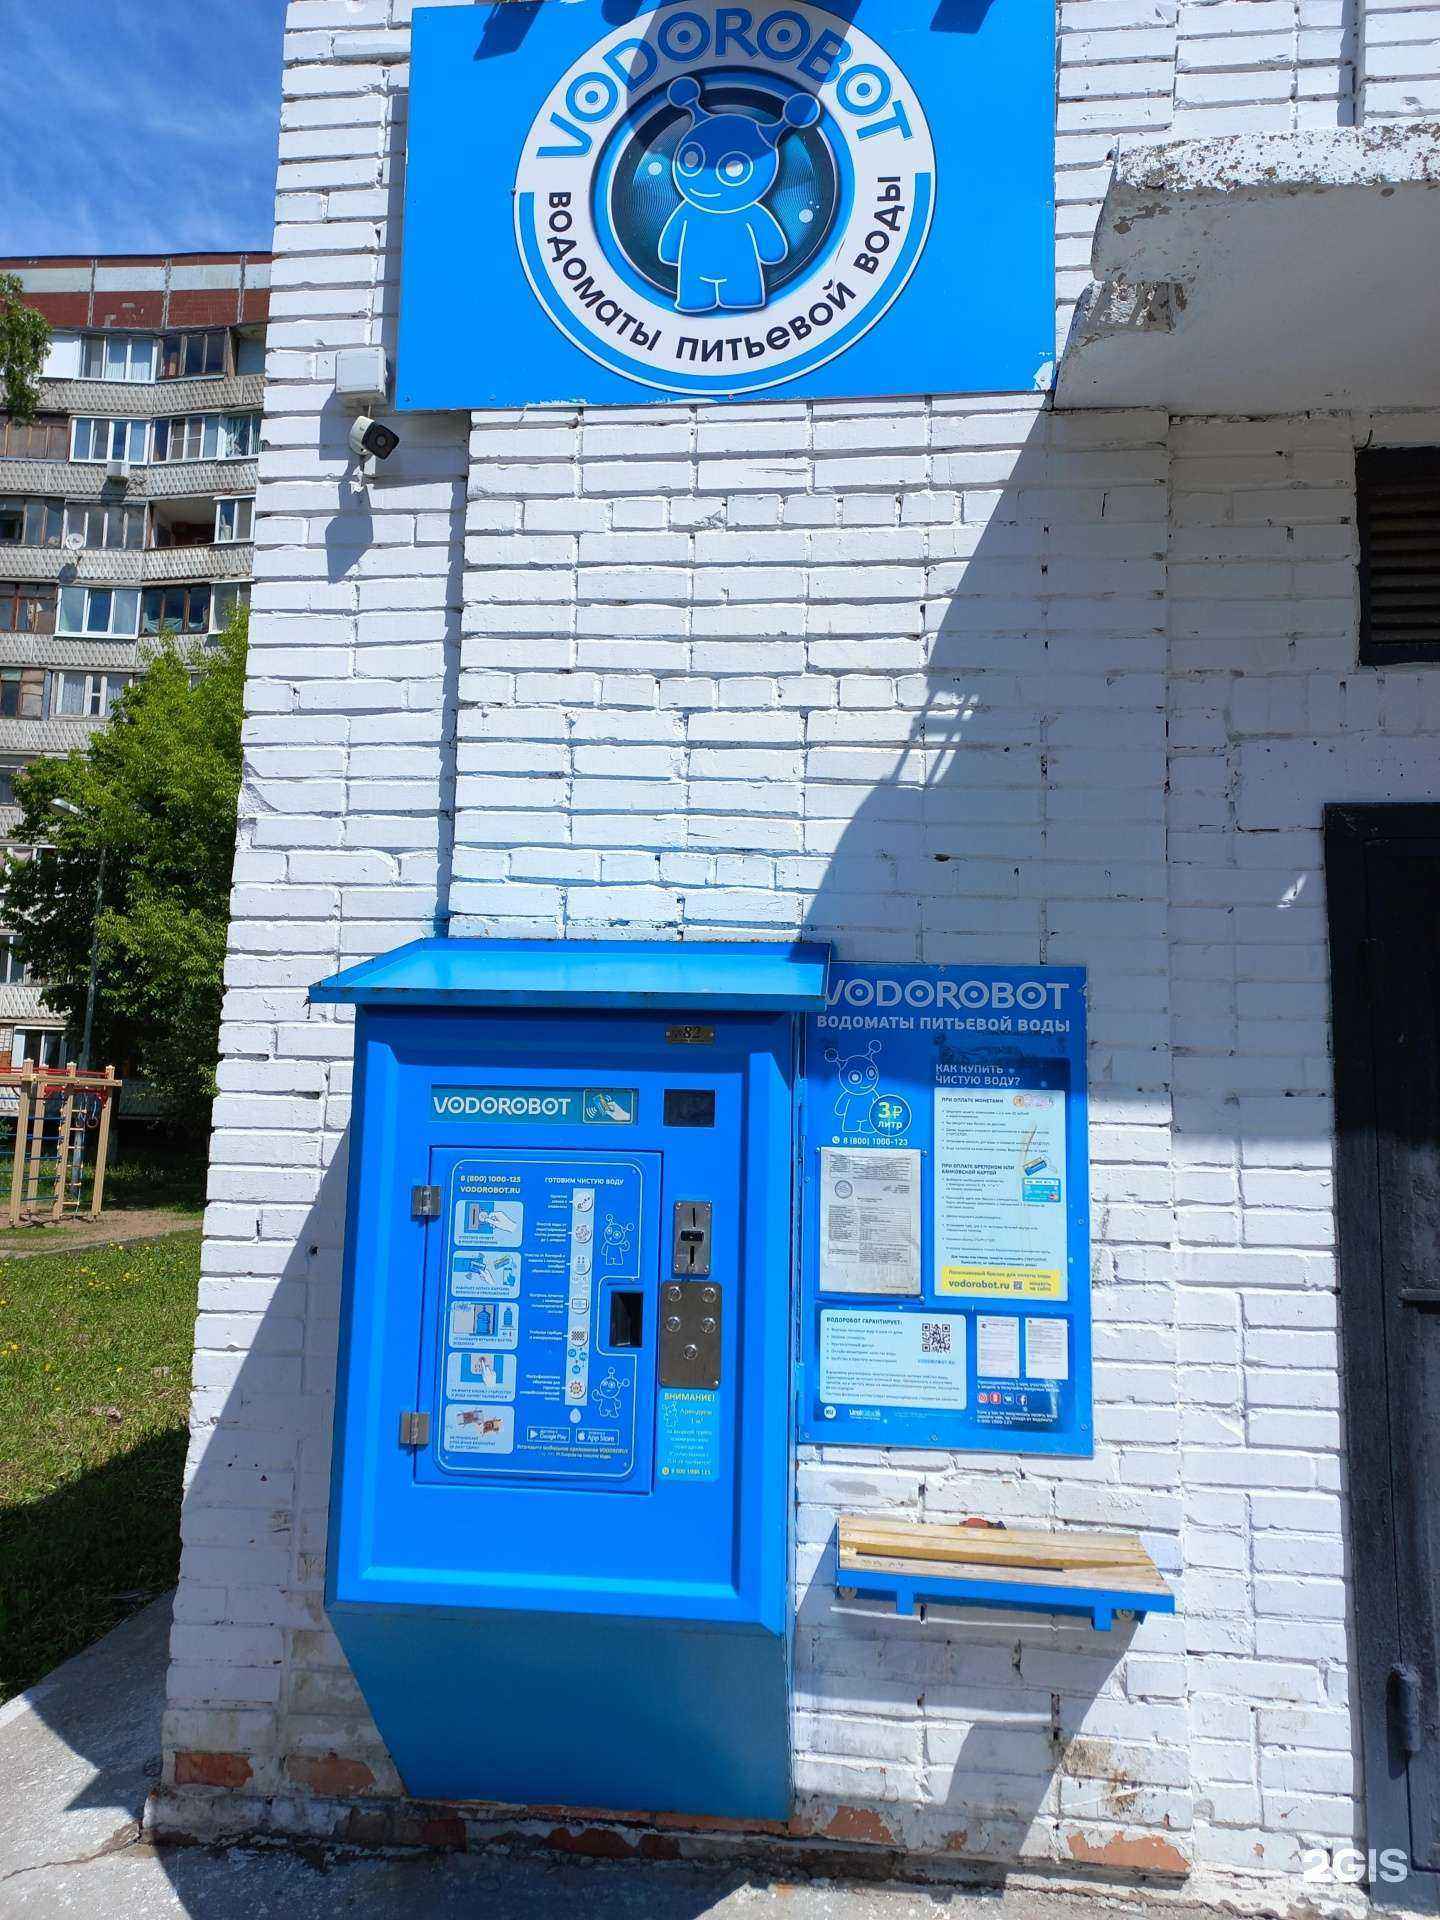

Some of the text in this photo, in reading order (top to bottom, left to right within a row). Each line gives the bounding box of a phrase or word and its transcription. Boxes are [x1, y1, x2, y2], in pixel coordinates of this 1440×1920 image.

[537, 7, 912, 160] VODOROBOT
[826, 978, 1071, 1010] VODOROBOT
[817, 1015, 1070, 1034] ВОДОМАТЫ ПИТЬЕВОЙ ВОДЫ
[936, 1063, 1004, 1074] КАК КУПИТЬ
[935, 1075, 1021, 1087] ЧИСТУЮ ВОДУ?
[433, 1096, 571, 1116] VODOROBOT
[878, 1121, 903, 1130] литр
[605, 1178, 624, 1186] ВОДУ
[460, 1186, 521, 1194] VODOROBOT.RU
[948, 1280, 1010, 1289] vodorobot.ru
[664, 1392, 715, 1402] ВНИМАНИЕ!
